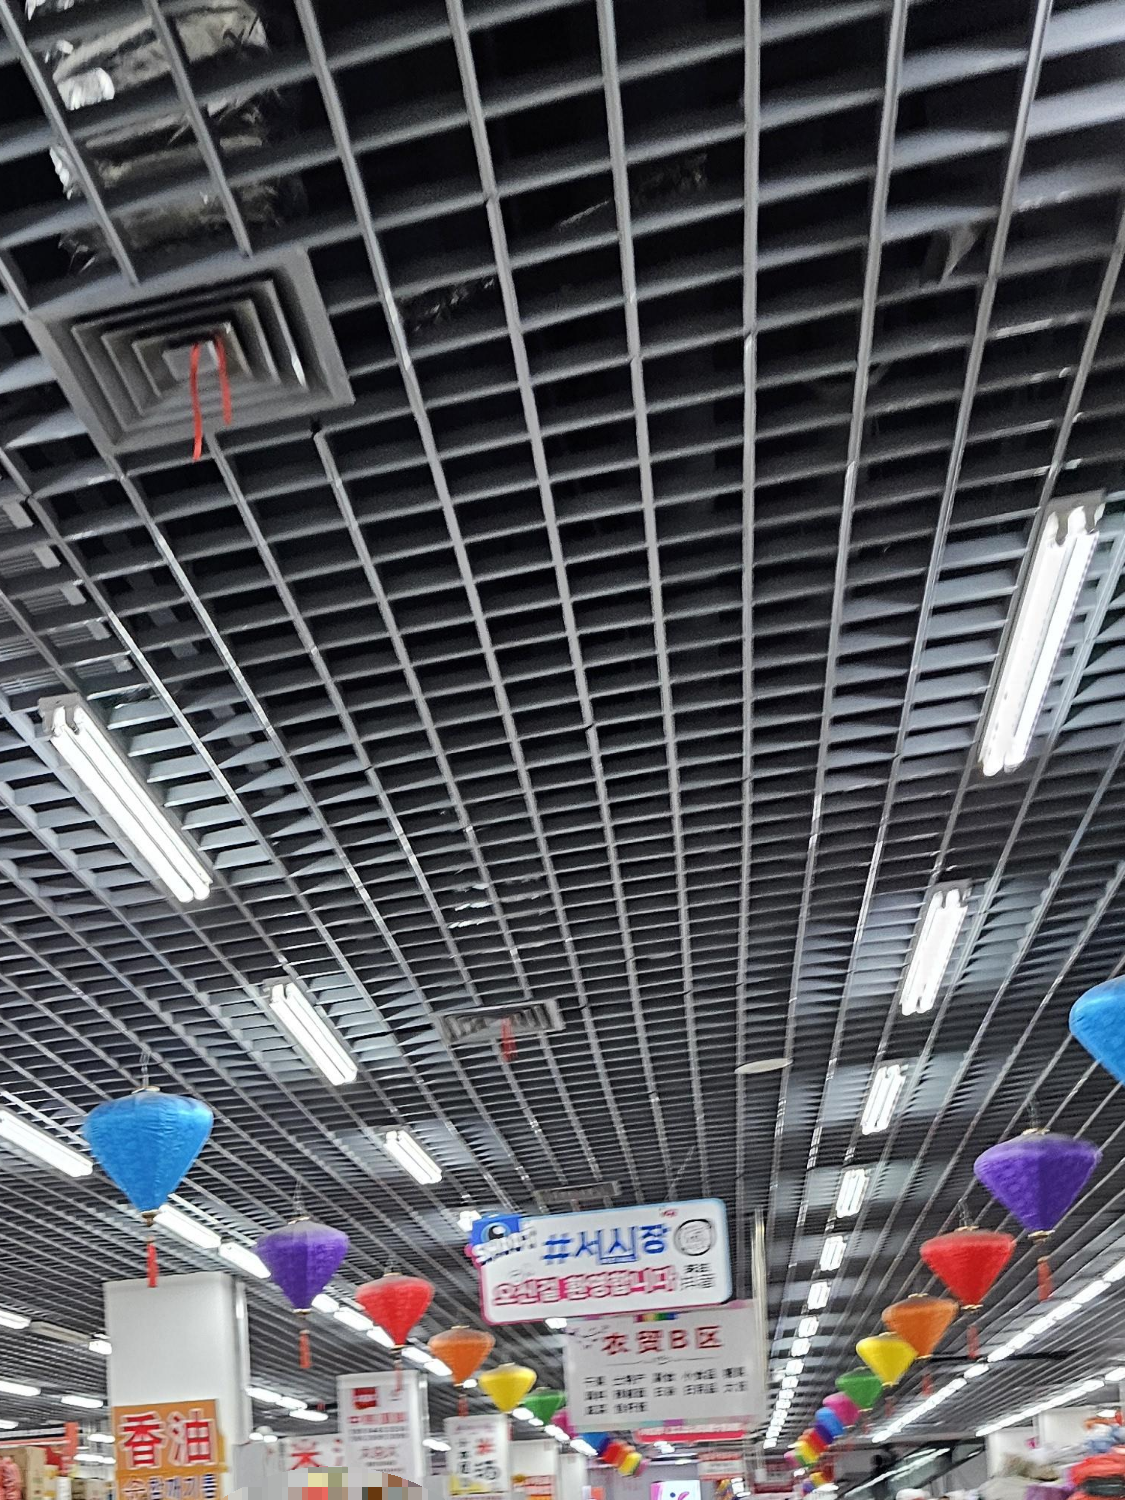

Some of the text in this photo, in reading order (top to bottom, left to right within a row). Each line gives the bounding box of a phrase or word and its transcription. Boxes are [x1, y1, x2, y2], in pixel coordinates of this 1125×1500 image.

[564, 1264, 679, 1300] 환영합니다
[602, 1325, 723, 1355] 农贸B区
[121, 1408, 216, 1469] 香油
